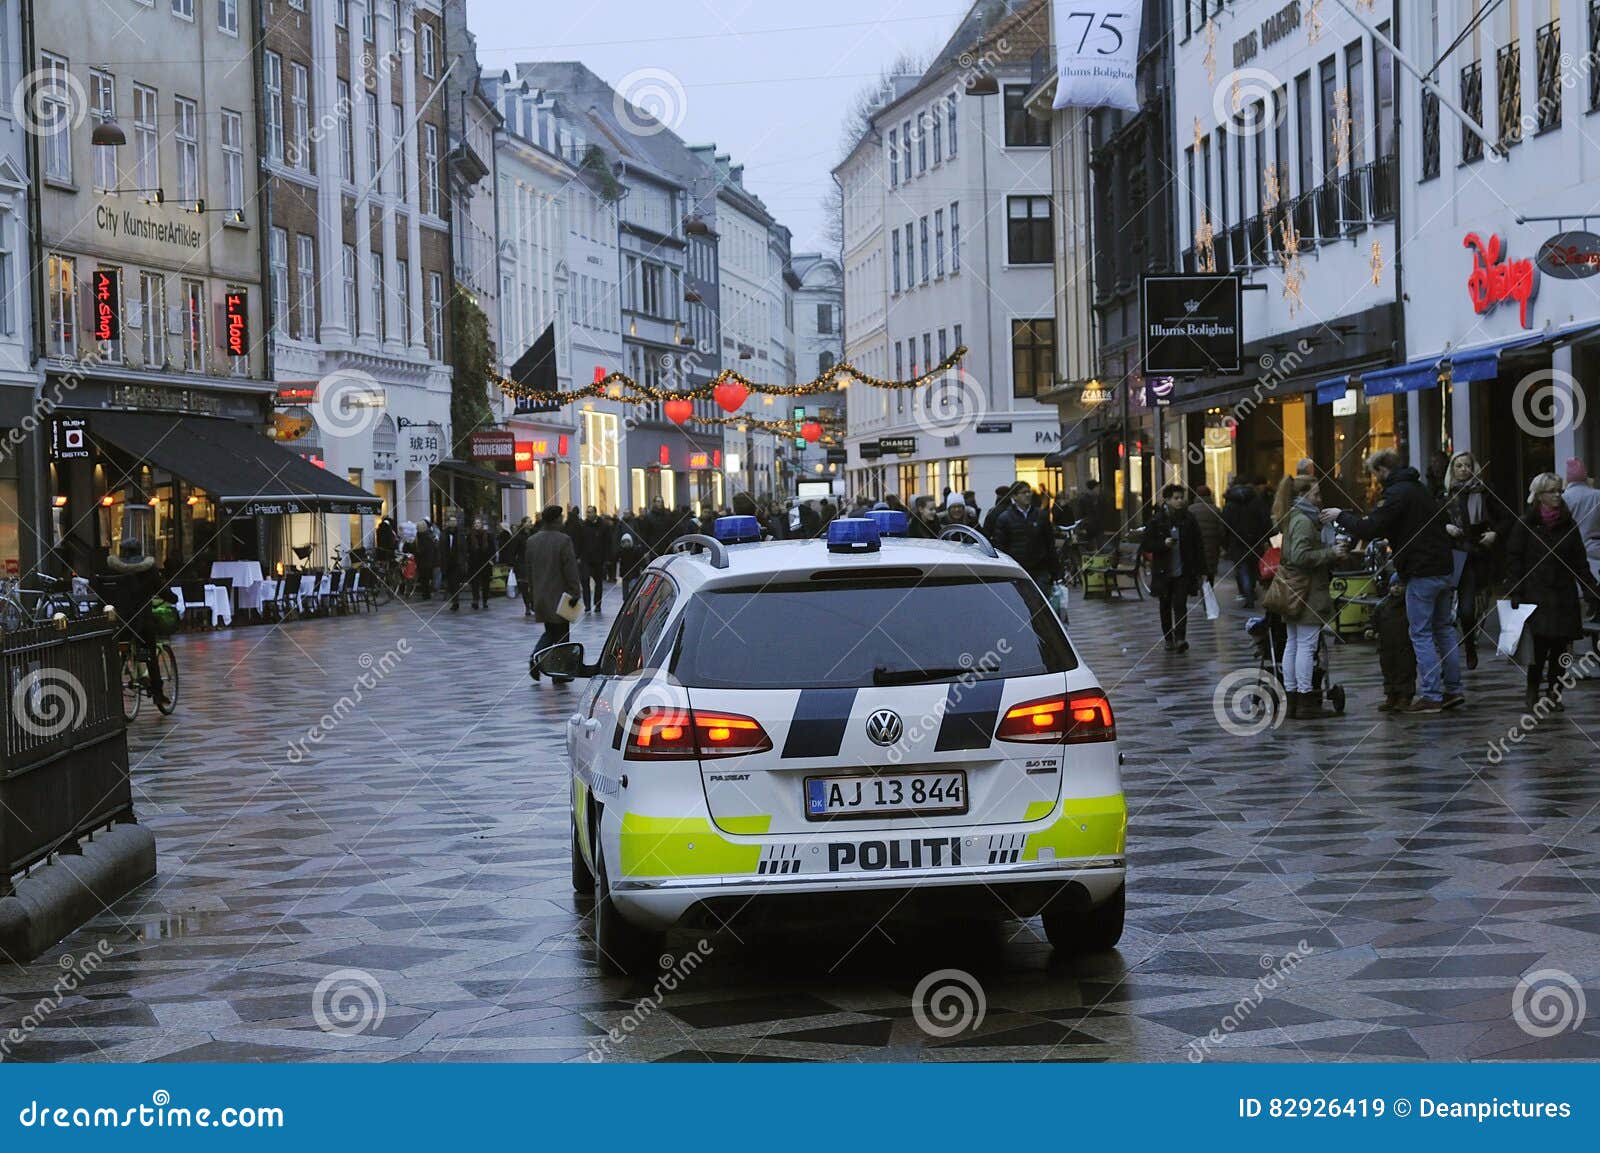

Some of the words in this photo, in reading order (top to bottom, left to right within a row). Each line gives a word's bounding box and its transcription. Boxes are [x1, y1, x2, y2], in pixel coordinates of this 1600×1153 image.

[1068, 12, 1123, 55] 75
[97, 204, 118, 237] City
[123, 210, 201, 248] KunstnerArtikler
[97, 273, 111, 300] Art
[1150, 324, 1185, 336] Illums
[1187, 323, 1234, 337] Bolighus
[472, 443, 513, 456] SOUVENIRS
[880, 439, 914, 447] CHANGE
[409, 453, 437, 463] コハク
[710, 774, 750, 782] PASSAT
[828, 782, 862, 808] AJ
[874, 780, 904, 805] 13
[911, 777, 960, 803] 844
[811, 800, 823, 808] DK
[828, 837, 962, 872] POLITI
